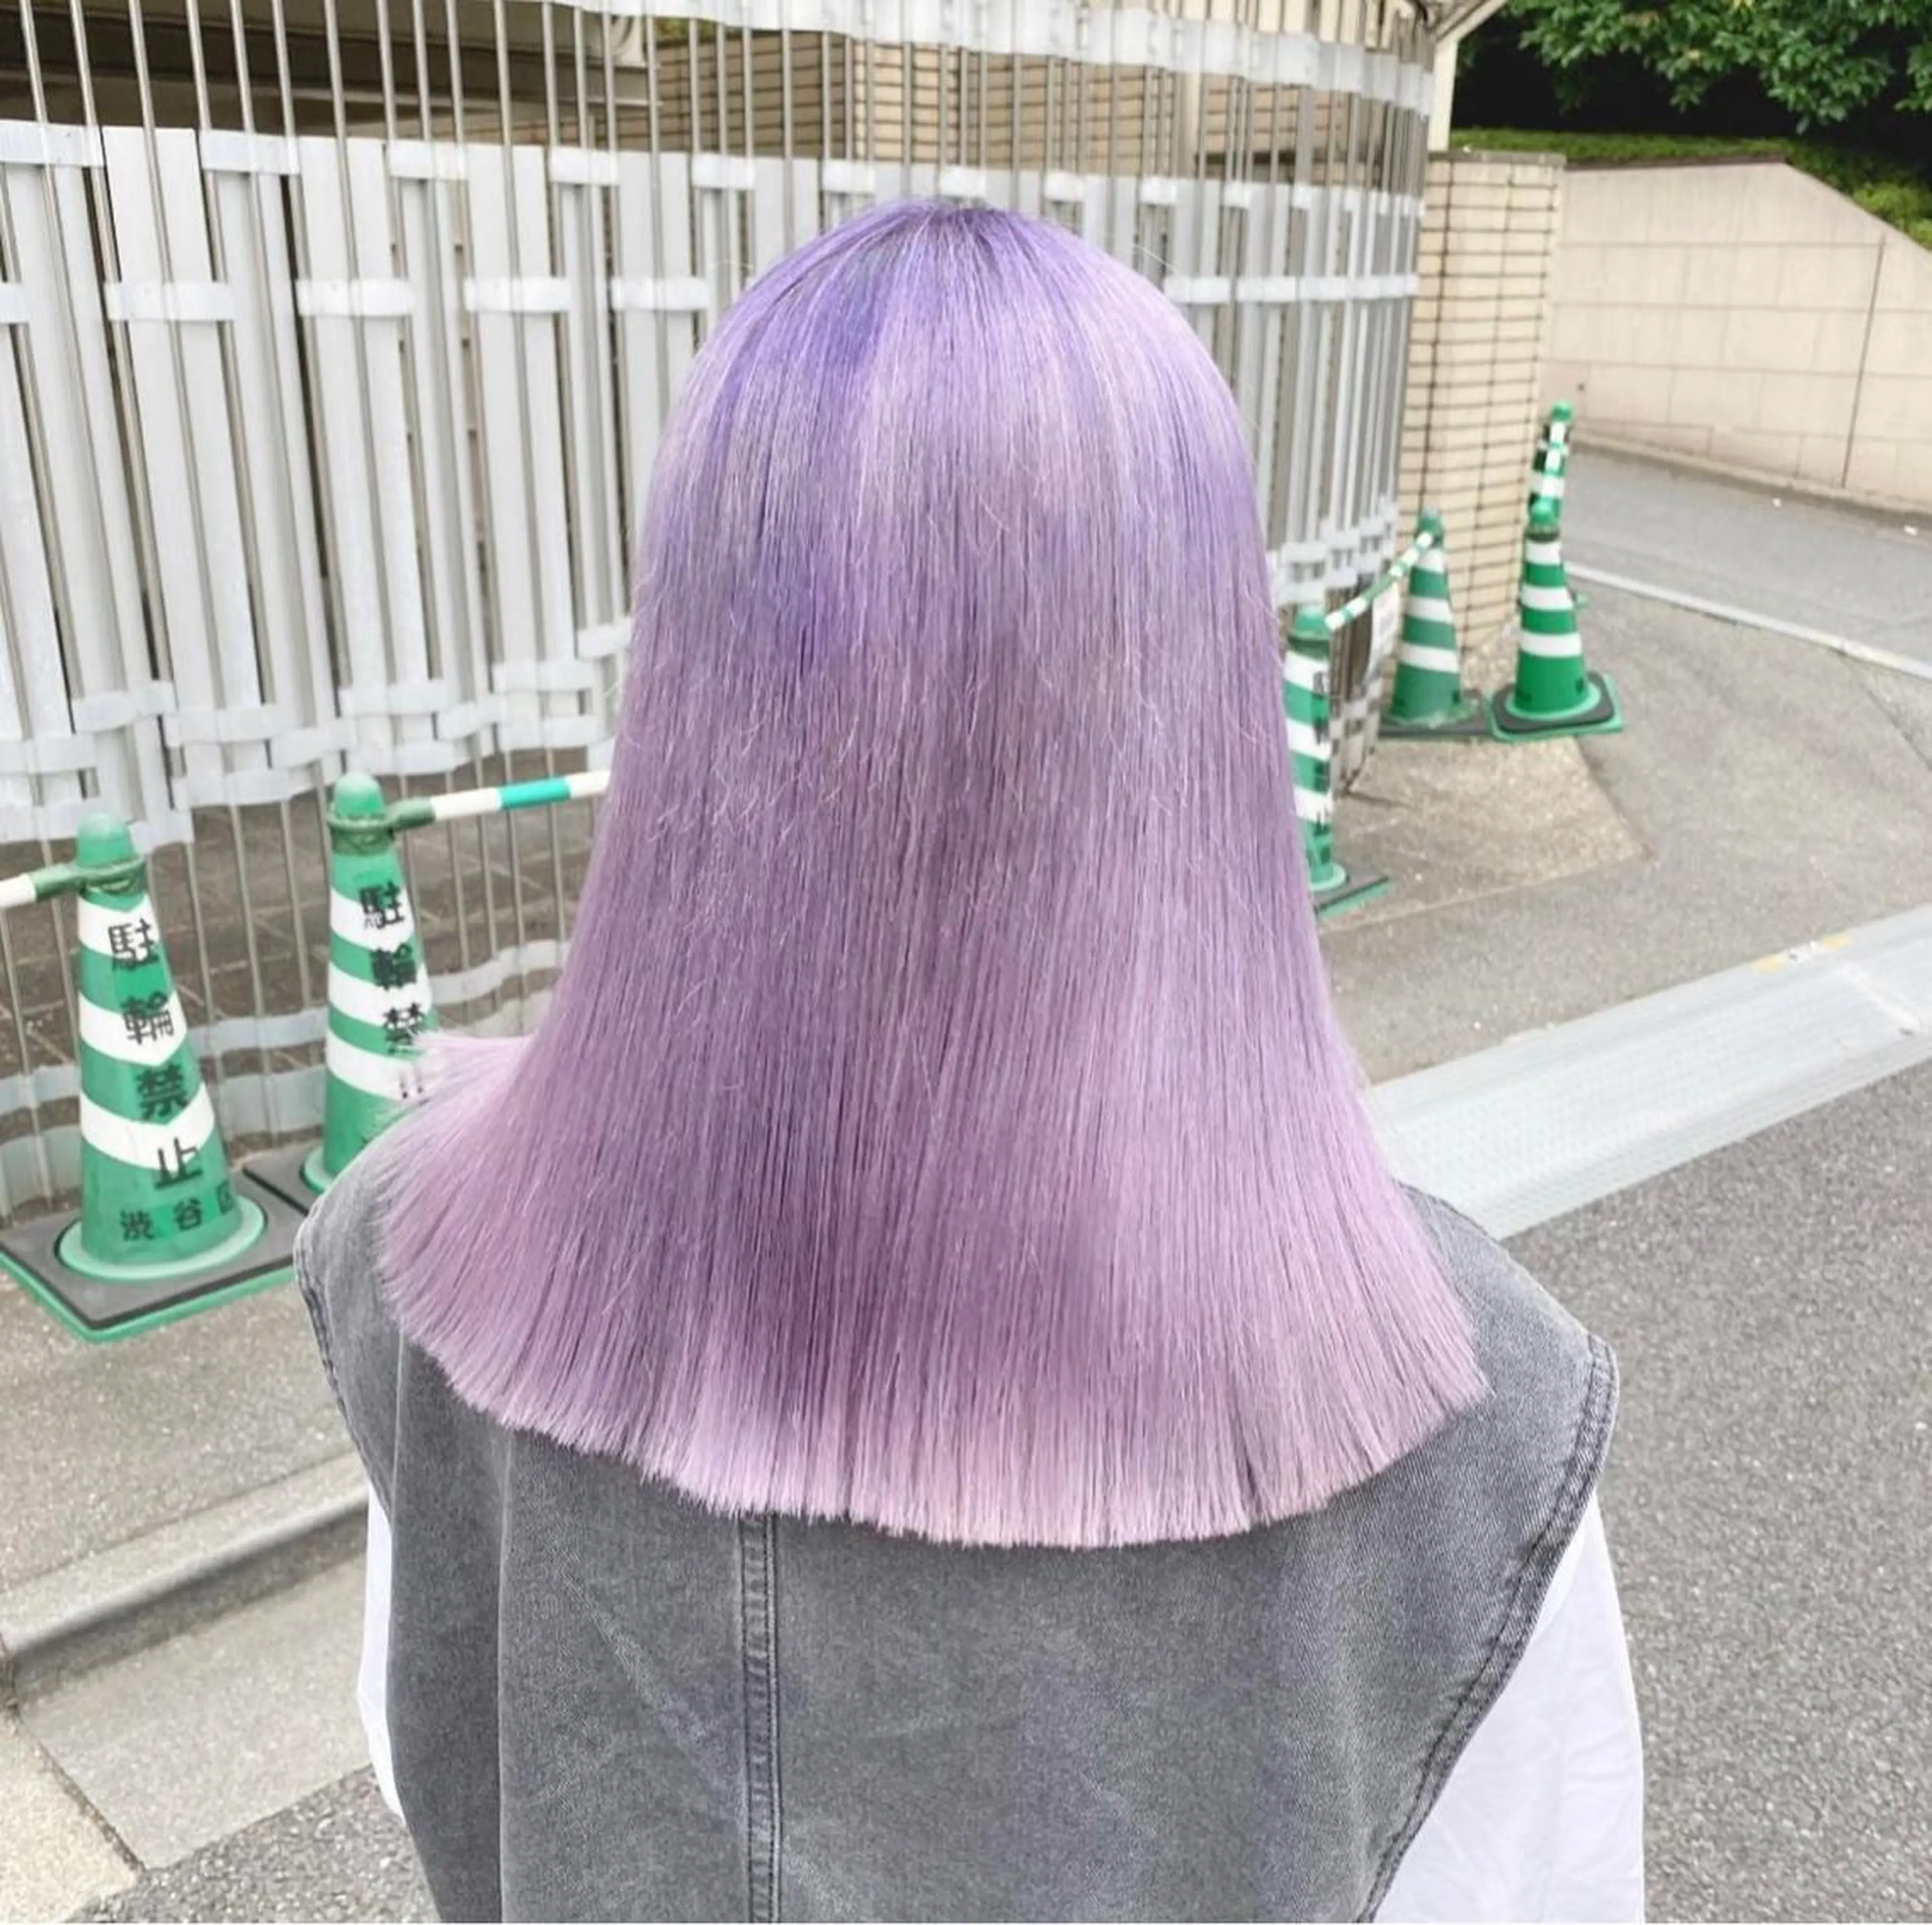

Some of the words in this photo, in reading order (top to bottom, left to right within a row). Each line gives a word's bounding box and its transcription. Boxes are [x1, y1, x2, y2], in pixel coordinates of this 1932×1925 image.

[108, 918, 204, 1190] 駐輪禁止
[359, 880, 426, 1099] 駐輪禁
